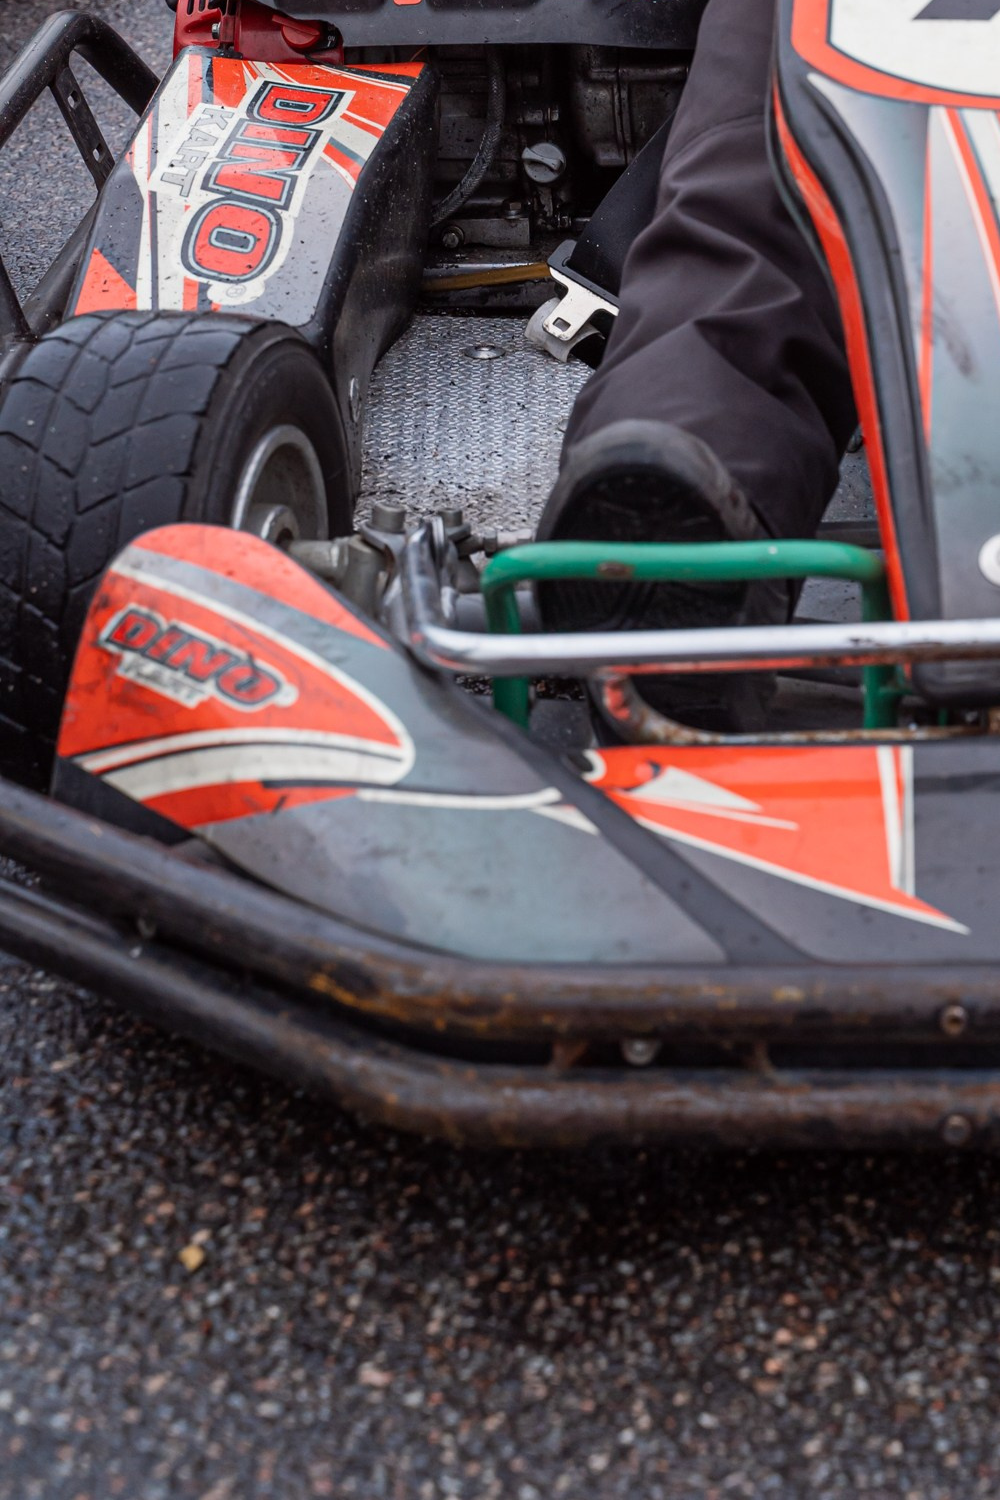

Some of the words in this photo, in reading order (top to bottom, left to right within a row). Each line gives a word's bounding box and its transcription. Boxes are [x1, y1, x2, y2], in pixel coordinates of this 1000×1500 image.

[160, 107, 235, 198] KART
[180, 80, 347, 284] DINO
[104, 609, 281, 706] DINO
